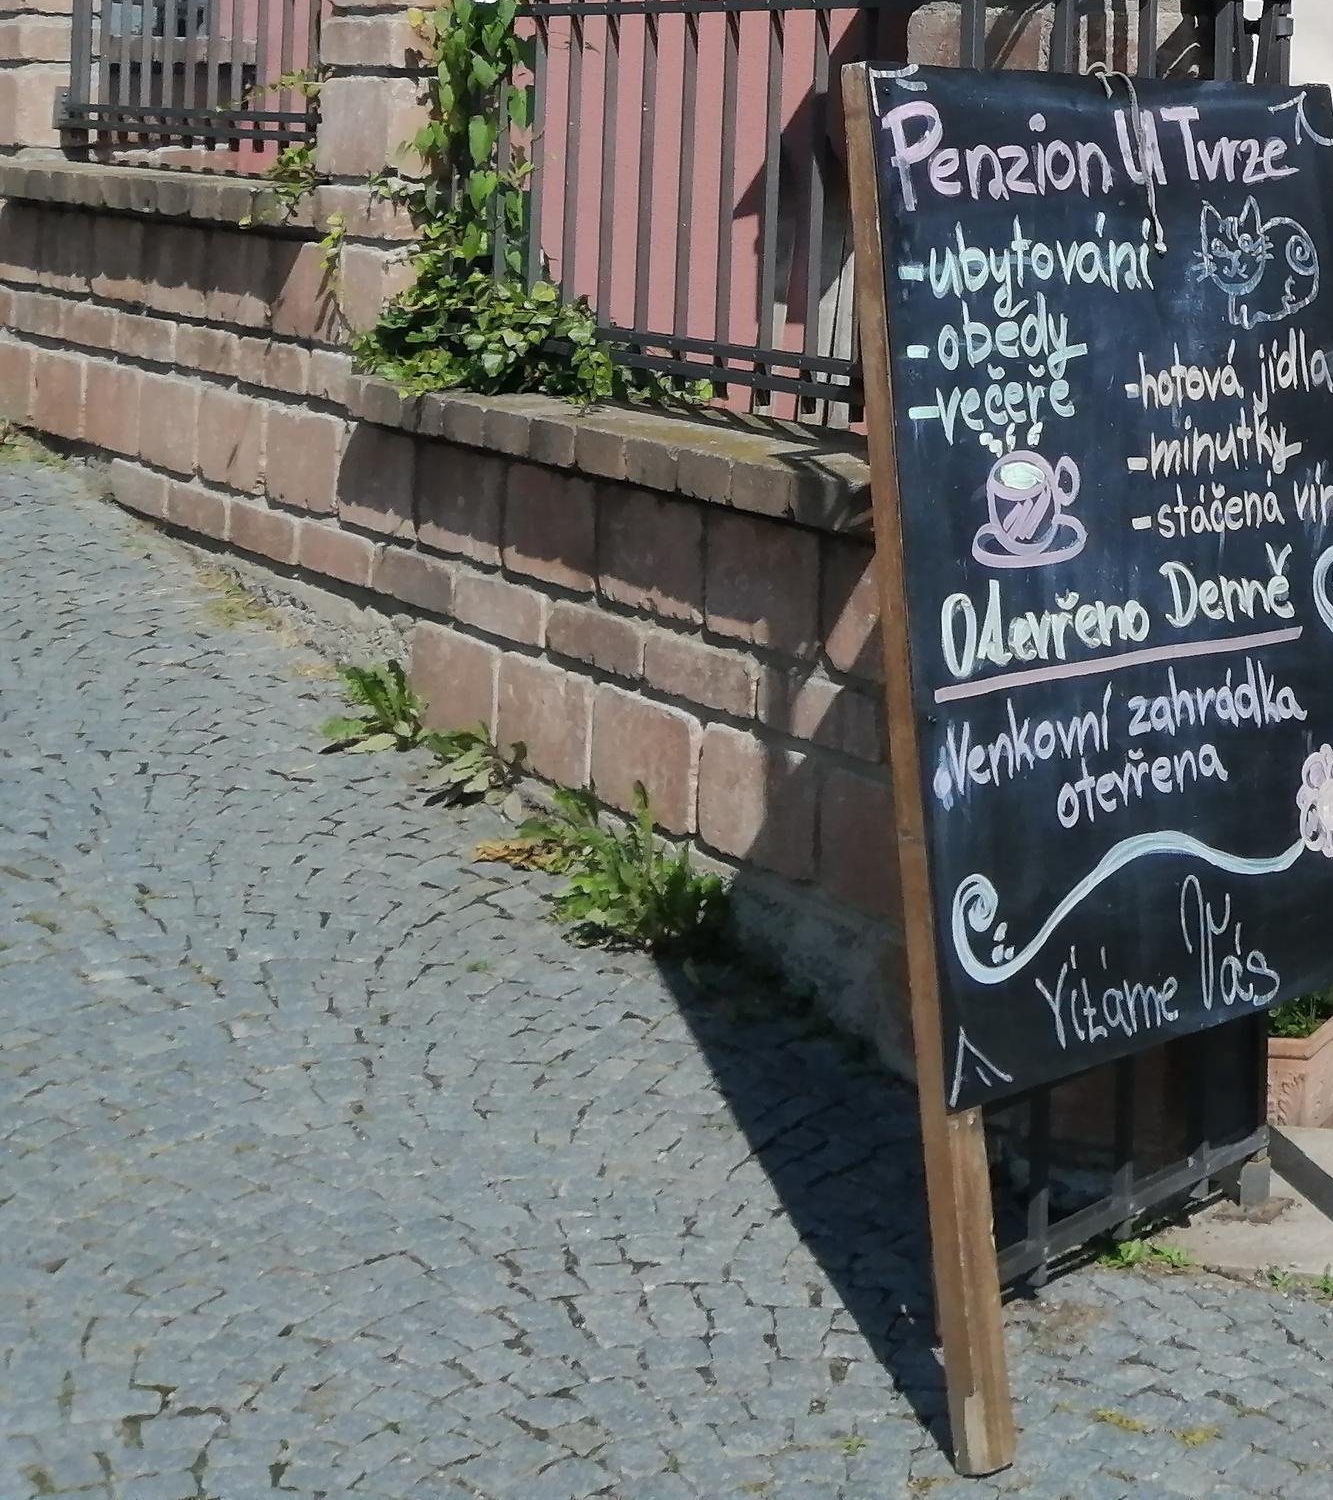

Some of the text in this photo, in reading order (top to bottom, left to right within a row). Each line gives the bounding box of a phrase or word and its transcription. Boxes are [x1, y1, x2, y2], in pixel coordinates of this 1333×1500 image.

[882, 101, 1114, 212] Penzion
[1160, 105, 1301, 184] Tvrze
[1158, 542, 1296, 629] Denně
[945, 656, 1309, 797] Venkovní zahrádka
[1056, 742, 1229, 829] otevřena
